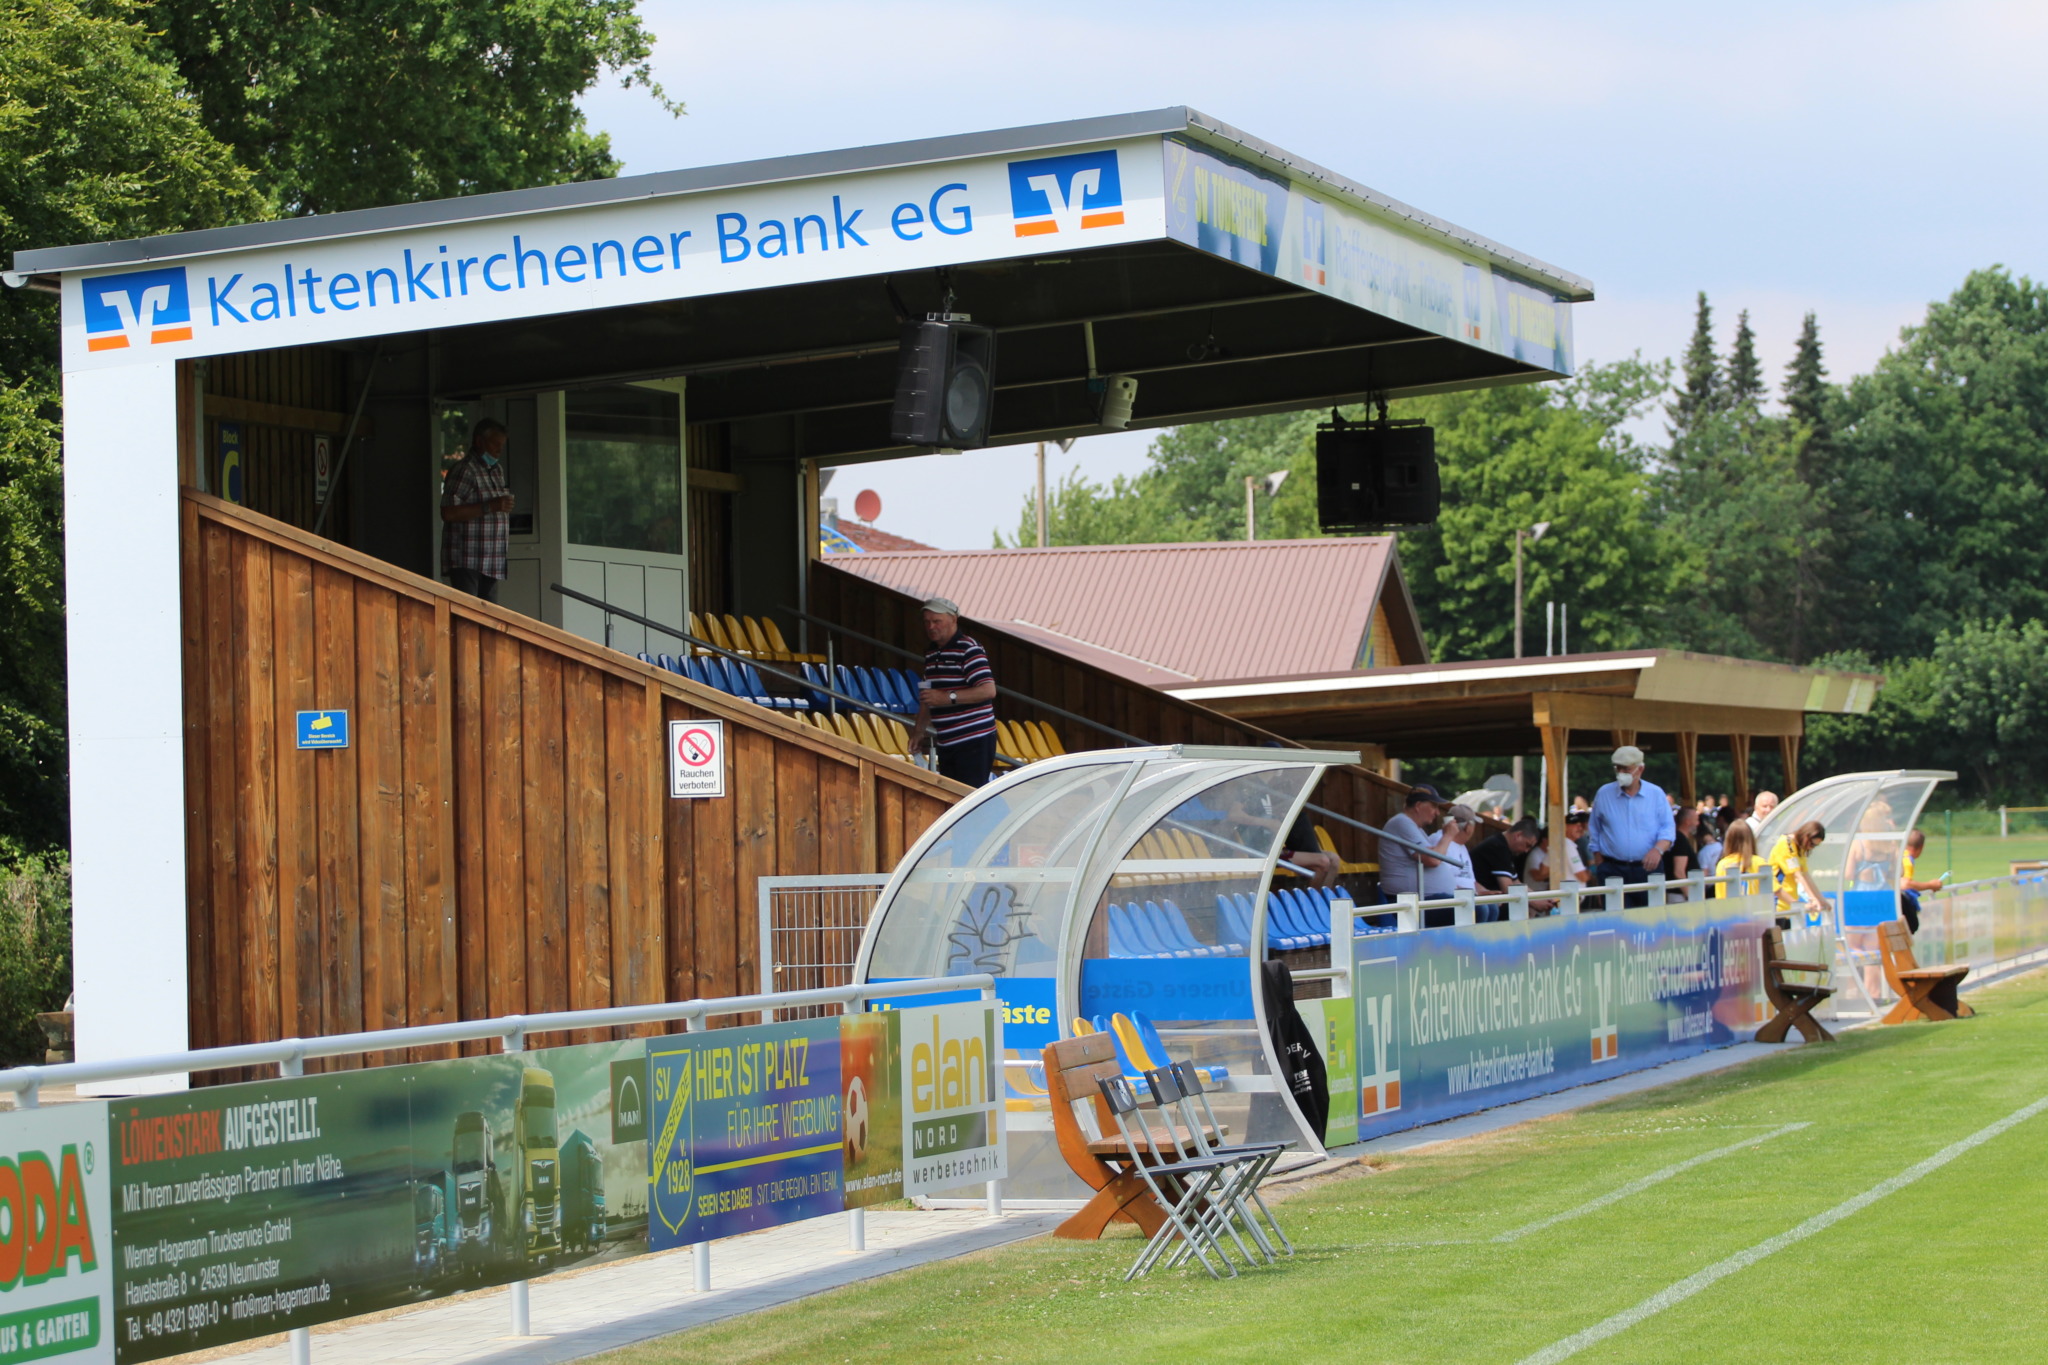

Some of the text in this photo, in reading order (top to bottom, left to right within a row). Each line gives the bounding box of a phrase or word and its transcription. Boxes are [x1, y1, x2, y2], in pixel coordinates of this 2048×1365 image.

[1195, 165, 1208, 224] SV
[1211, 172, 1267, 246] TODESFELDE
[207, 183, 973, 327] Kaltenkirchener Bank eG
[222, 429, 239, 444] Block
[679, 780, 717, 790] verboten!
[680, 769, 715, 778] Rauchen
[1619, 925, 1751, 1006] Raiffeisenbank eG Leezen
[1002, 1001, 1051, 1024] äste
[1409, 944, 1582, 1046] Kaltenkirchener Bank eG
[655, 1066, 671, 1102] SV
[695, 1037, 810, 1102] HIER IST PLATZ
[1447, 1036, 1554, 1095] www.kaltenkirchener-bank.de
[121, 1096, 321, 1166] LÖWENSTARK AUFGESTELLT.
[619, 1109, 640, 1128] MAN
[655, 1070, 690, 1172] TODESFELDE
[727, 1094, 837, 1149] FÜR IHRE WERBUNG
[915, 1124, 958, 1150] NORD
[123, 1153, 344, 1213] Mit Ihrem zuverlässigen Partner in Ihrer Nähe.
[666, 1158, 691, 1195] 1928
[845, 1168, 903, 1193] www.elan-nord.de
[913, 1150, 999, 1185] werbetechnik
[698, 1169, 839, 1218] SEIEN SIE DABEI! SVT. EINE REGION. EIN TEAM.
[124, 1216, 292, 1270] Werner Hagemann Truckservice GmbH
[125, 1272, 180, 1306] Havelstraße
[180, 1271, 188, 1296] 8
[200, 1263, 228, 1292] 24539
[229, 1256, 281, 1286] Neumünster
[22, 1322, 32, 1349] &
[35, 1310, 90, 1347] GARTEN
[126, 1315, 144, 1342] Tel.
[145, 1309, 163, 1337] +49
[164, 1305, 187, 1333] 4321
[187, 1299, 219, 1330] 9981-0
[231, 1278, 331, 1321] info@man-hagemann.de
